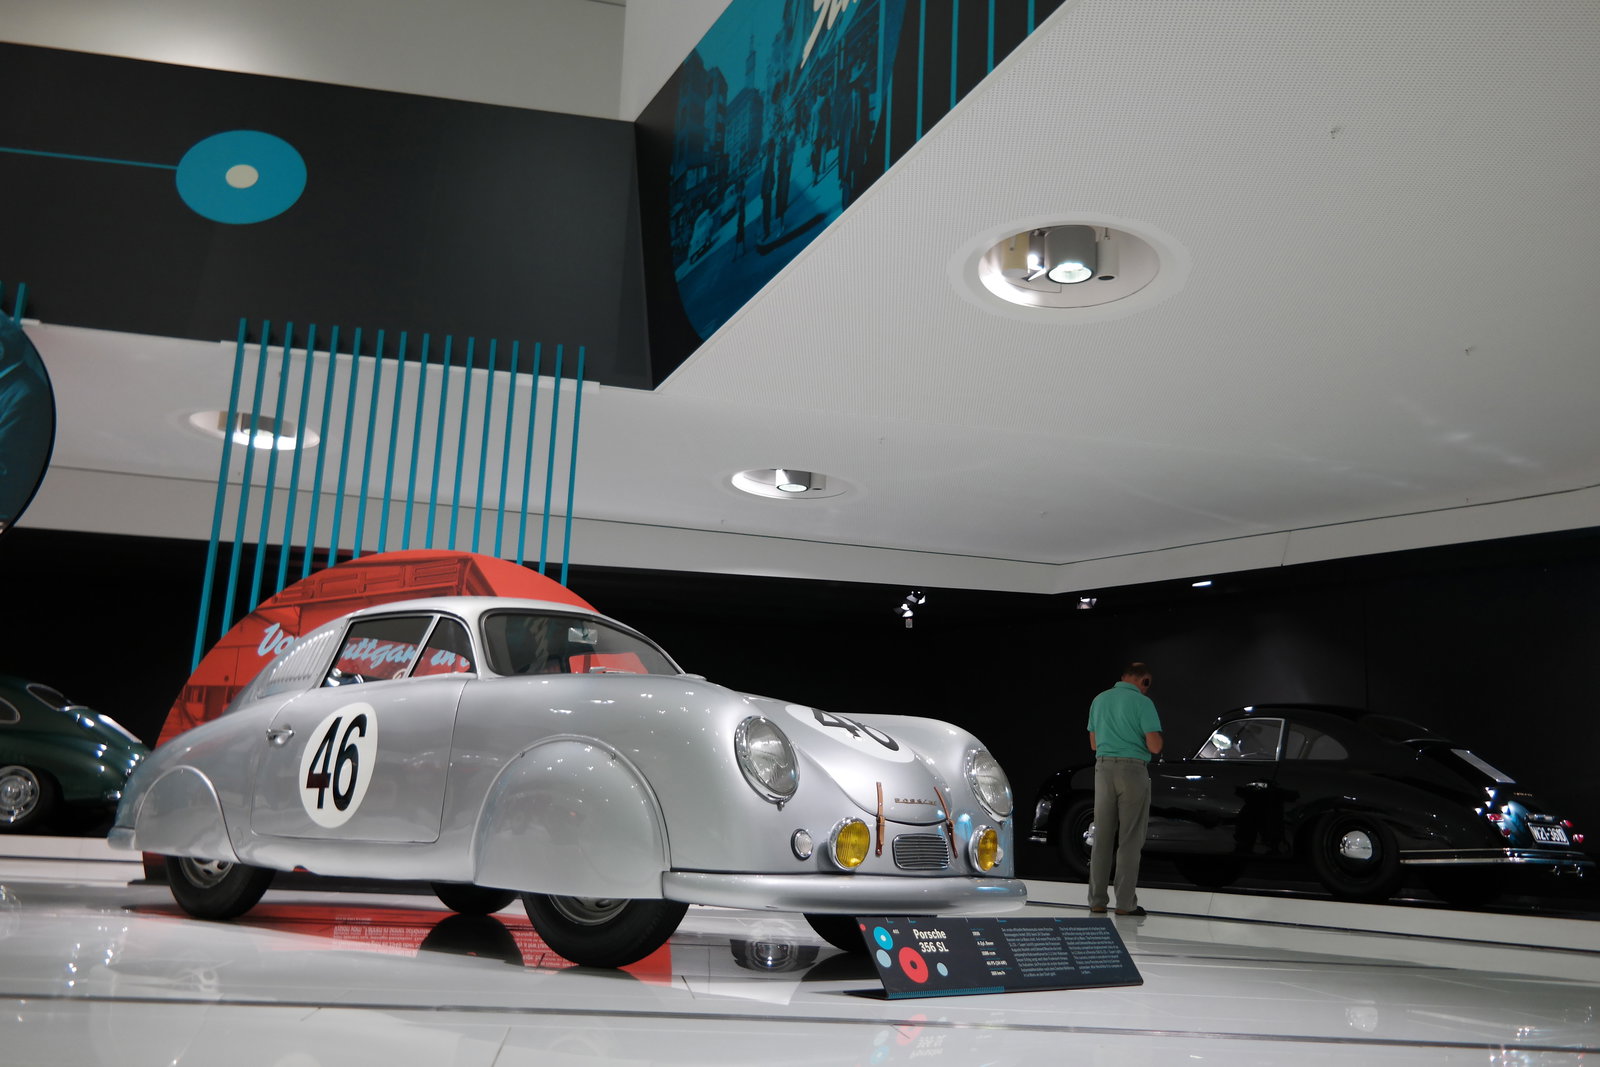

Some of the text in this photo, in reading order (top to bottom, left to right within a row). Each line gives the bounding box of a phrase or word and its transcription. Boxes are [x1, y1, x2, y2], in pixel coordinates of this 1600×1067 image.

[306, 713, 368, 811] 46
[913, 928, 947, 940] Porsche
[919, 941, 949, 953] 356 SL
